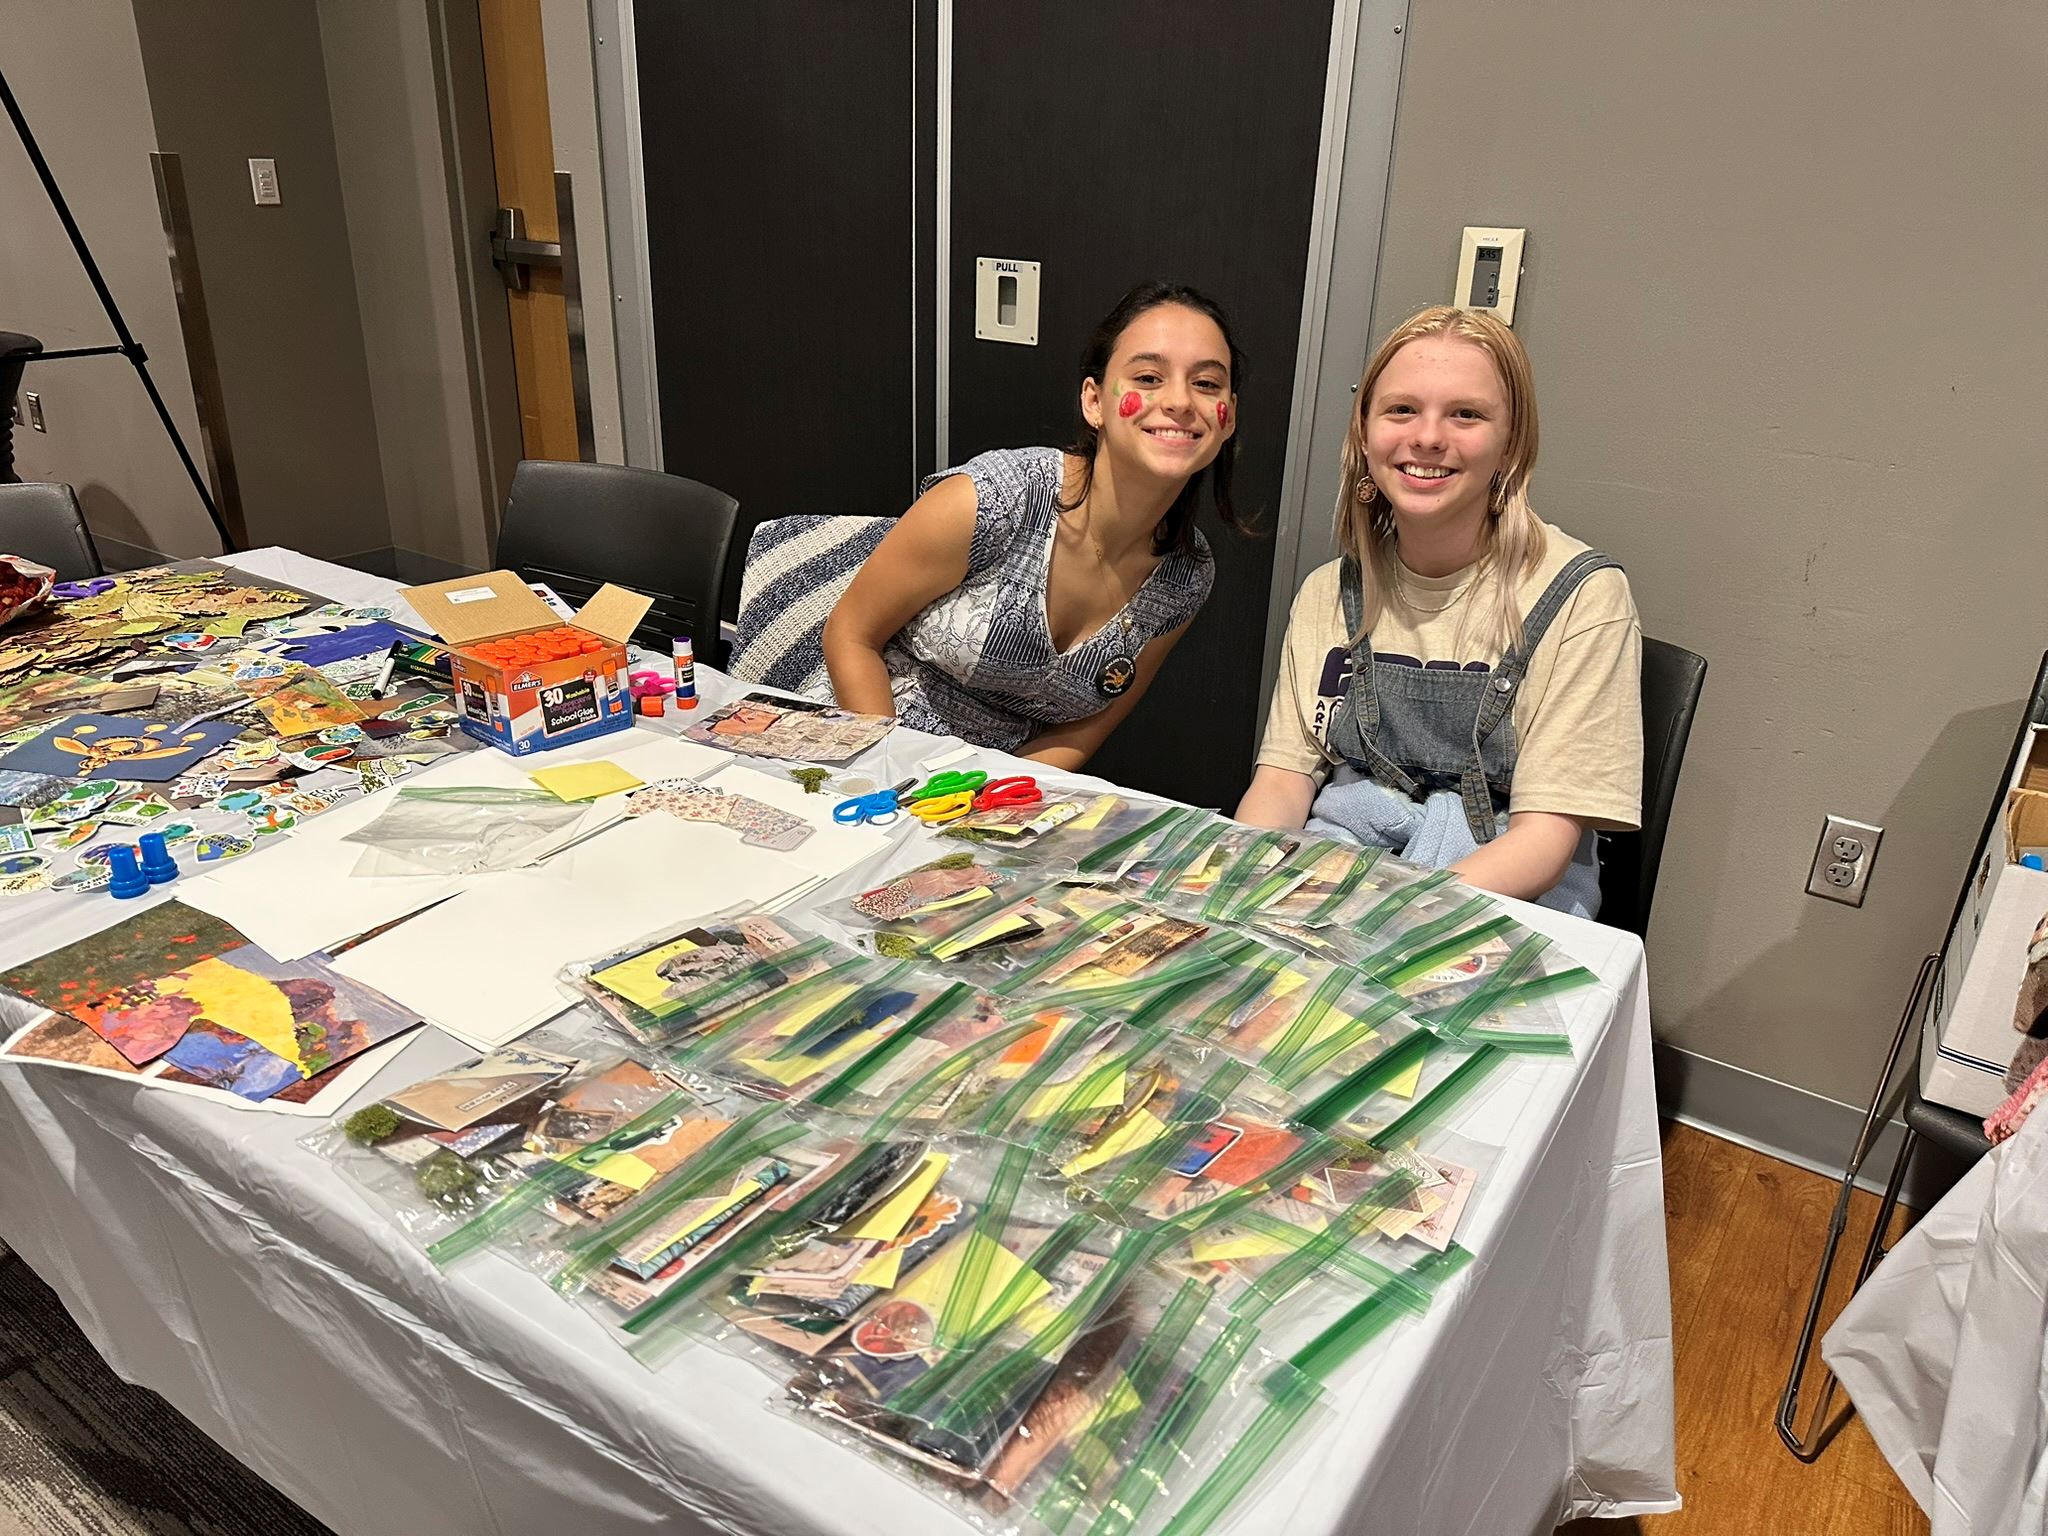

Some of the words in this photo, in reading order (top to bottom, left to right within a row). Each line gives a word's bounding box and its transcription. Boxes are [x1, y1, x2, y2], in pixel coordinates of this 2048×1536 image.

[996, 262, 1018, 272] PULL
[463, 681, 472, 697] 30
[513, 680, 541, 691] ELMER'S
[543, 688, 564, 707] 30
[551, 711, 577, 726] School
[578, 707, 594, 718] Glue
[518, 740, 530, 749] 30
[111, 815, 149, 826] DECIDE
